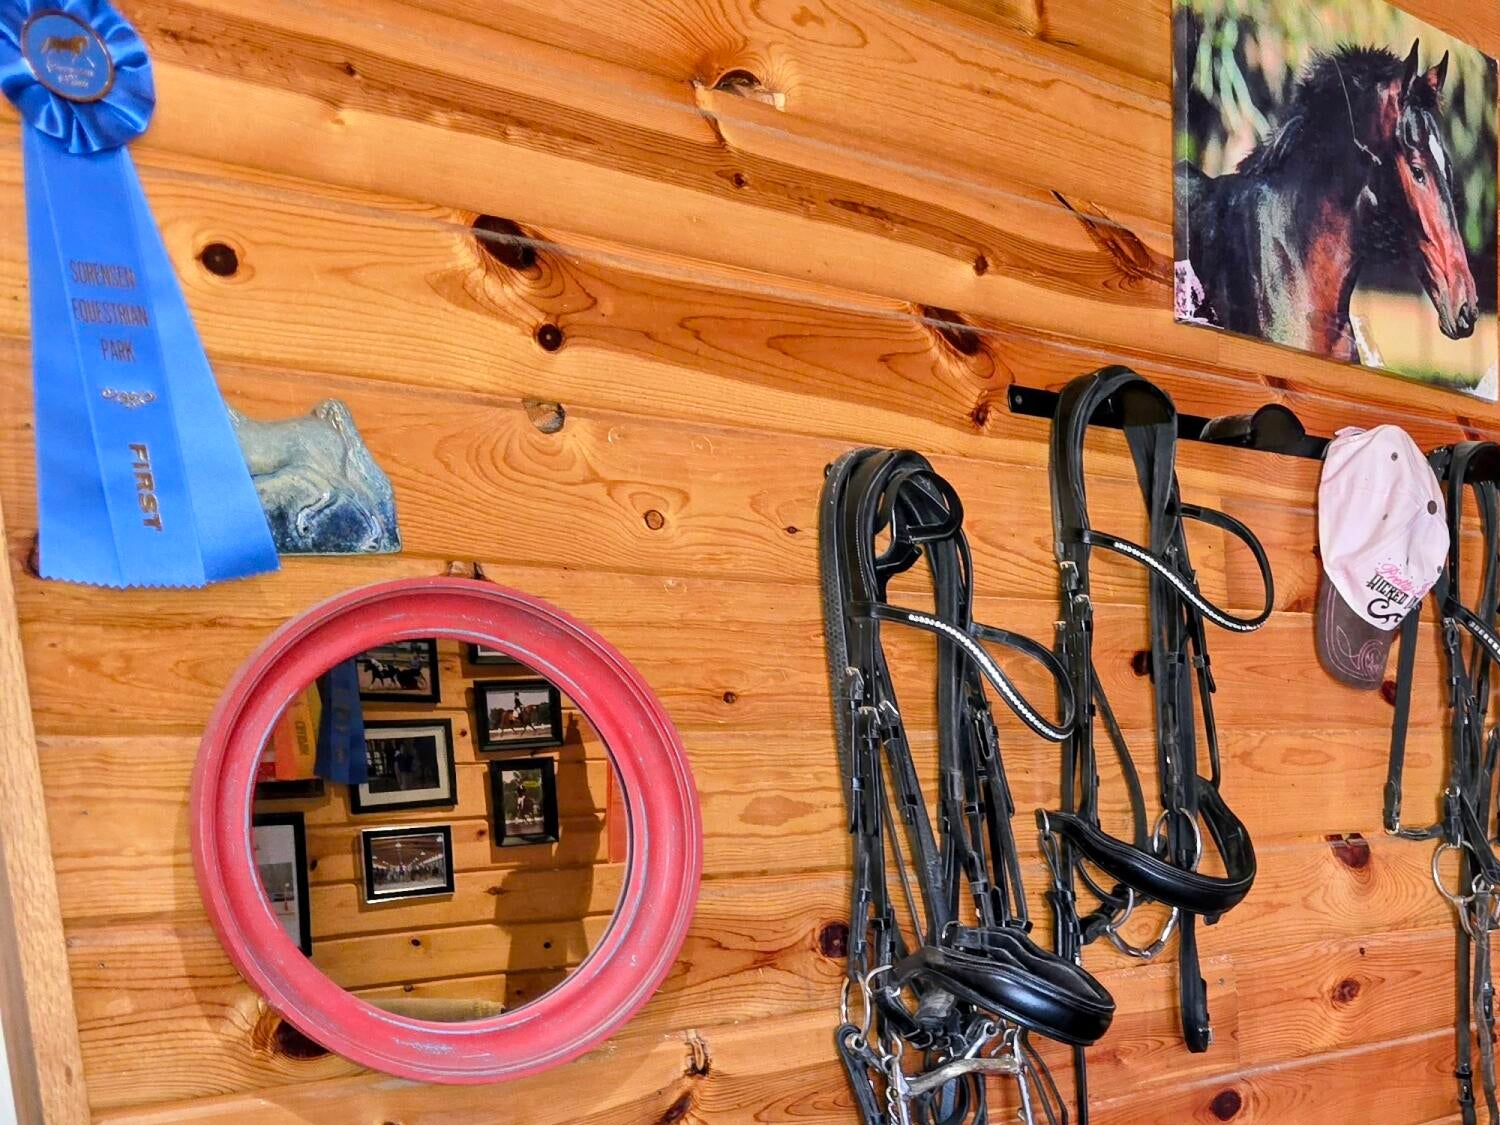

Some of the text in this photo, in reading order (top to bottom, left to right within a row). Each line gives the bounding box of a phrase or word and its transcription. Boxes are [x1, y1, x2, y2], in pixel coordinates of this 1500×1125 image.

[71, 298, 149, 327] EQUESTRIAN
[100, 337, 135, 362] PARK
[127, 443, 163, 532] FIRST
